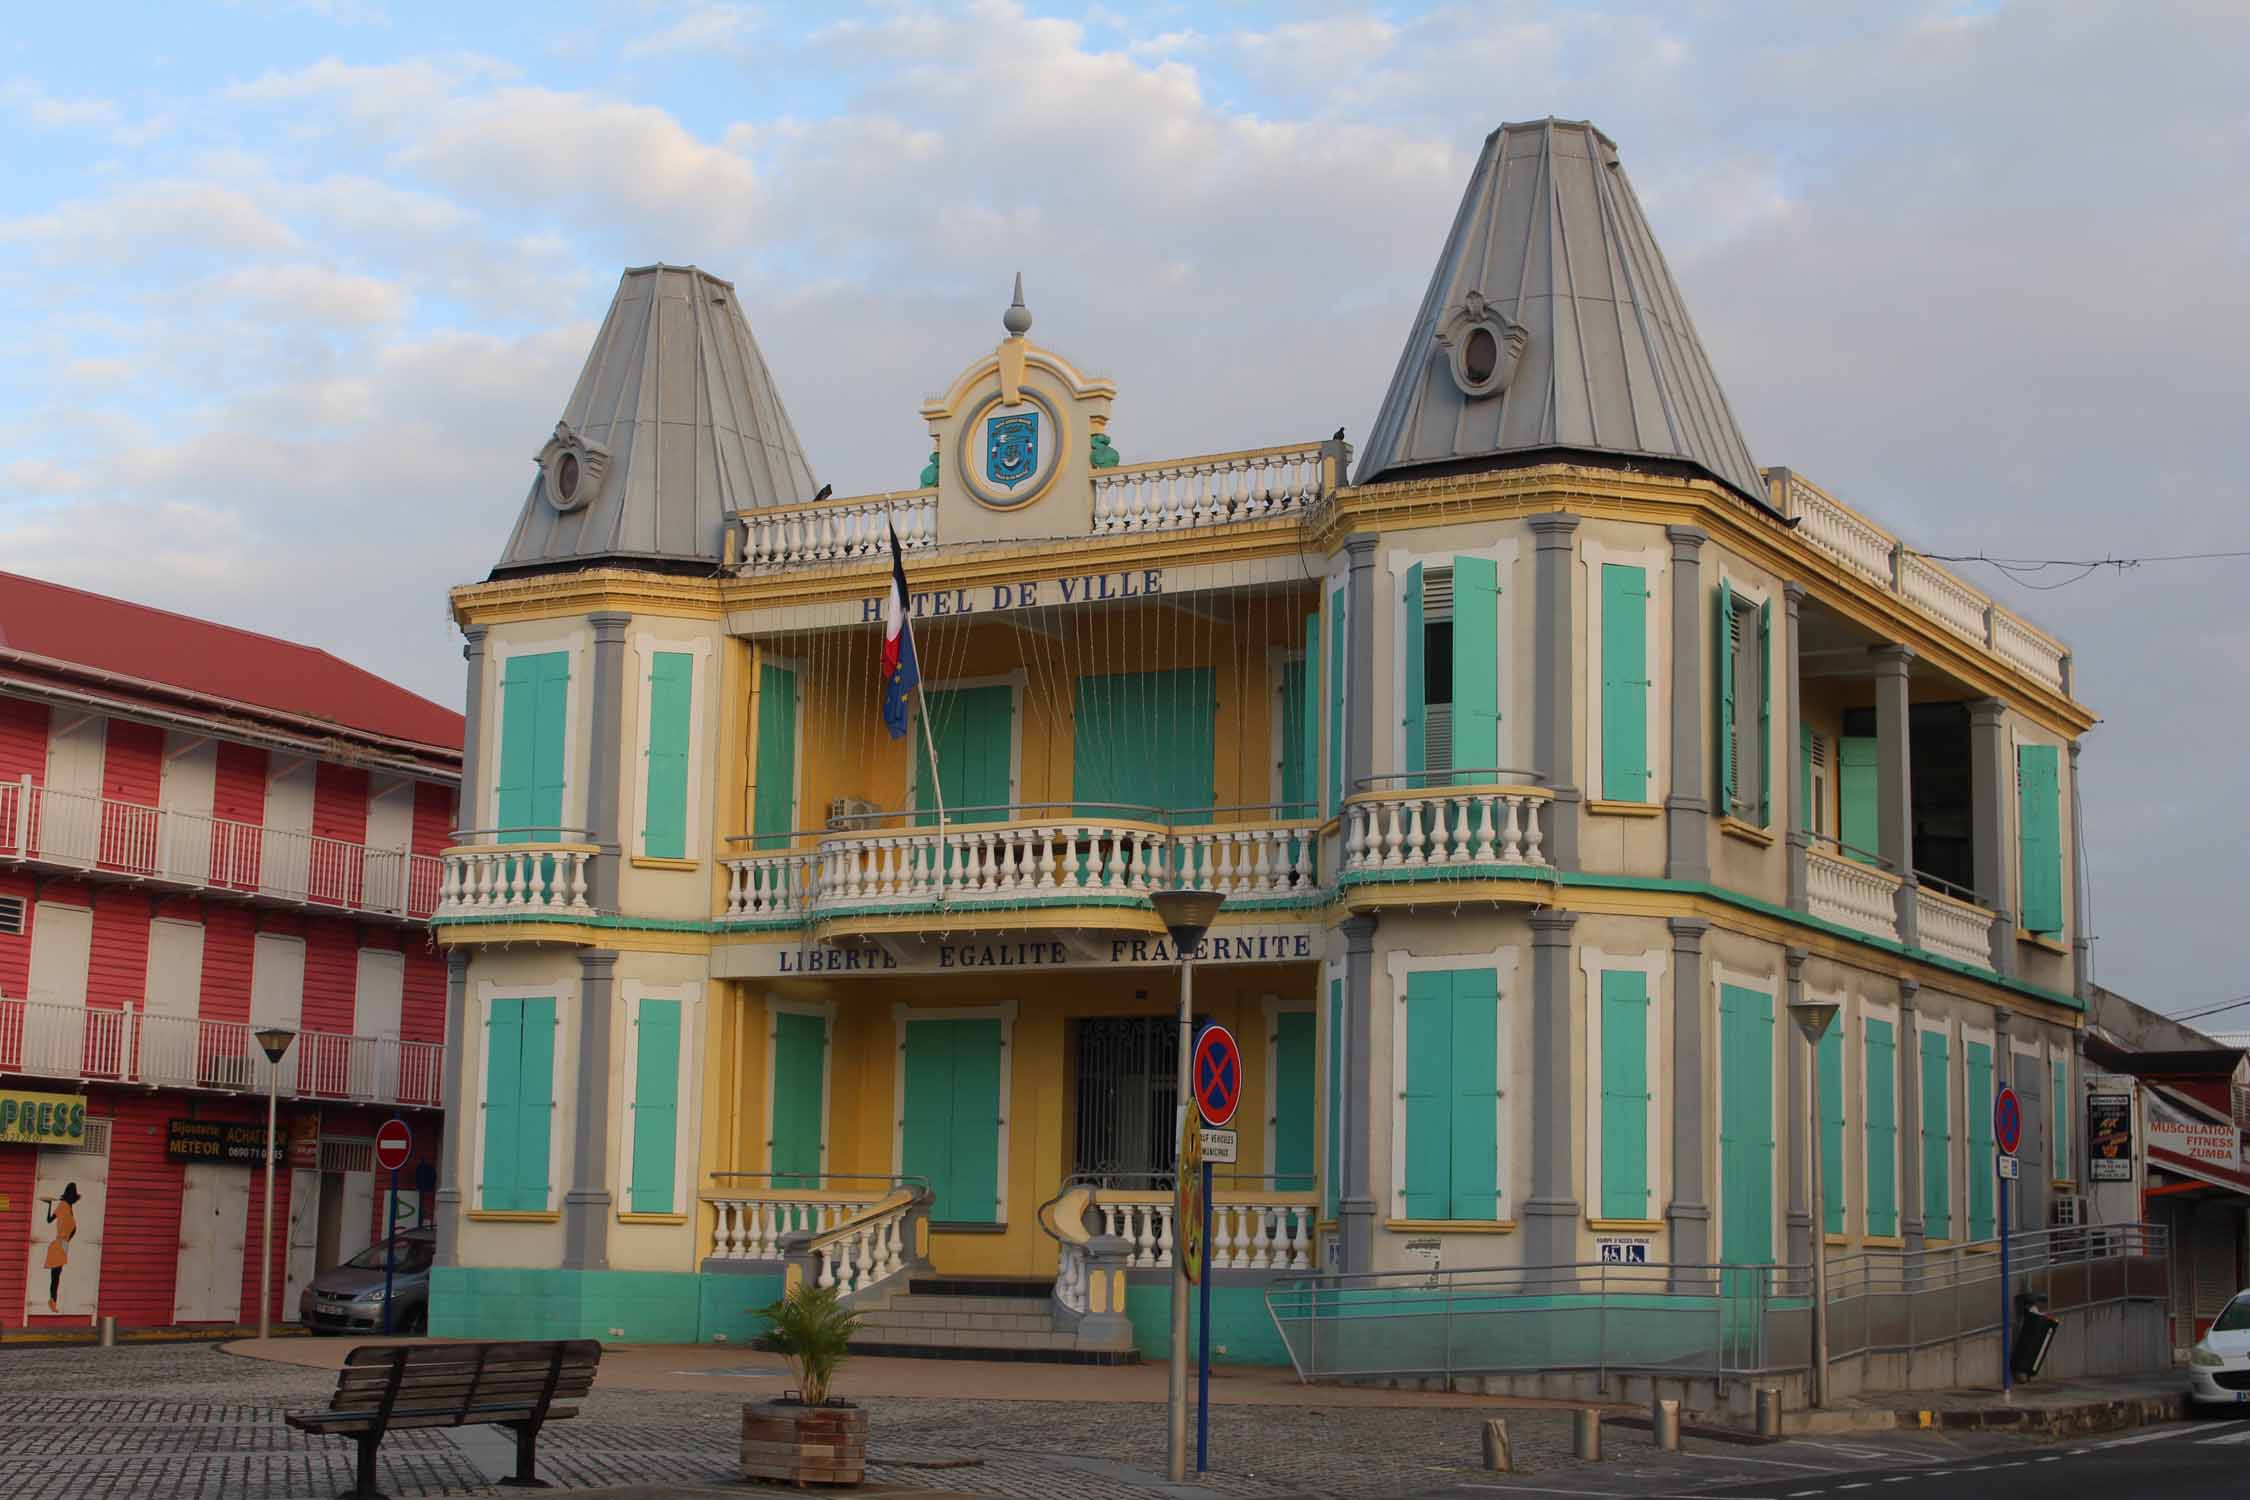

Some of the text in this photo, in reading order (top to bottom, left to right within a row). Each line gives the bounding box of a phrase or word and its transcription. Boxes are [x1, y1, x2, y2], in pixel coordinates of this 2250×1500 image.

[862, 569, 1163, 622] HTEL DE VILLE
[779, 948, 898, 972] LIBERTE
[939, 941, 1066, 968] EGALITE
[2151, 1120, 2234, 1137] MUSCULATION
[2186, 1136, 2233, 1148] FITNESS
[2190, 1147, 2233, 1160] ZUMBA
